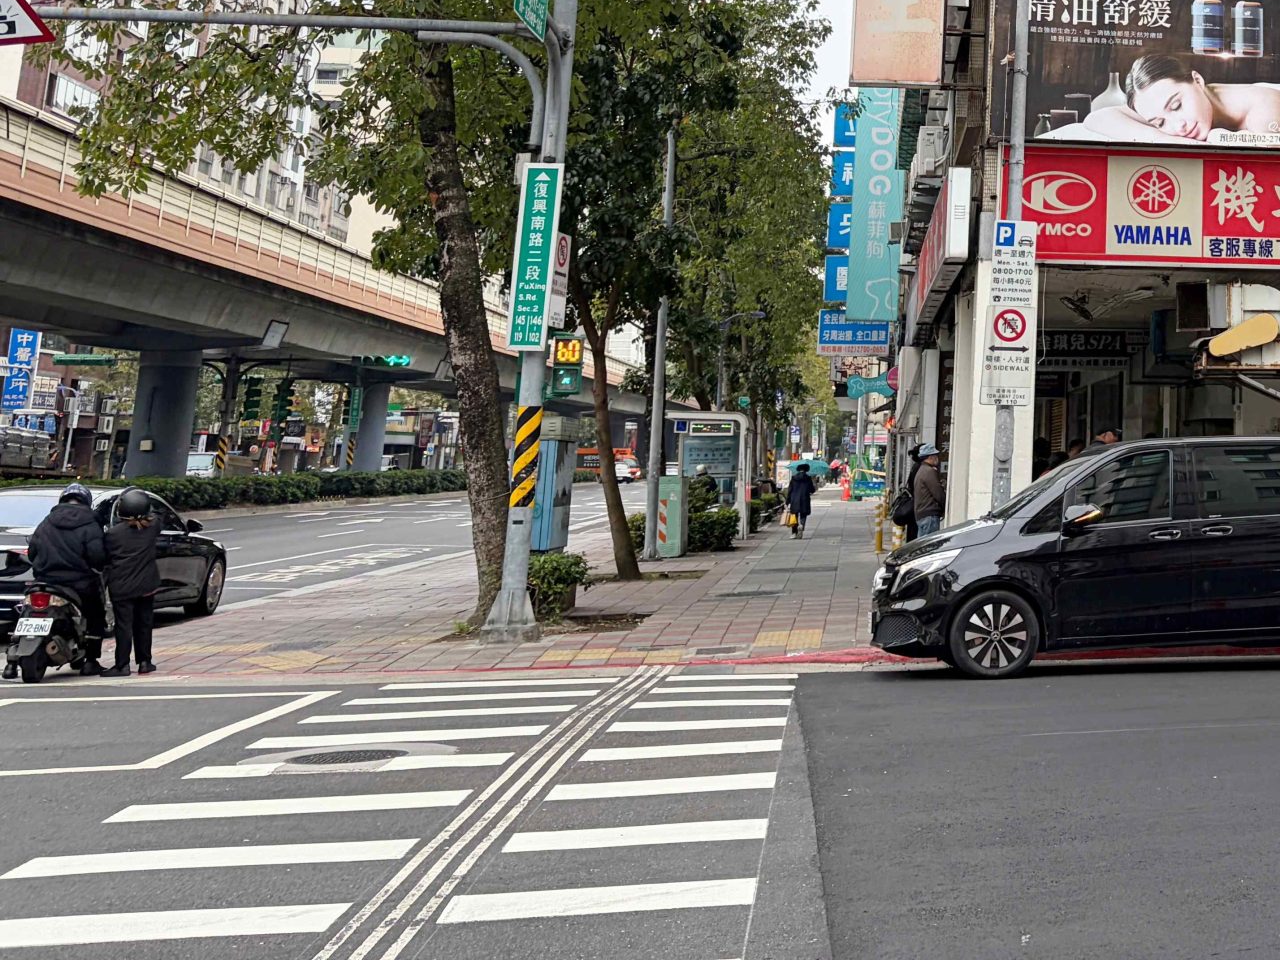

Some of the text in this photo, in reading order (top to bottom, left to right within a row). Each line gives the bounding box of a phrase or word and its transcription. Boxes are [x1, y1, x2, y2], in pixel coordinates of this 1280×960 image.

[525, 182, 548, 281] 復興南路二段
[866, 201, 887, 258] 蘇菲狗
[999, 226, 1012, 243] P
[1036, 223, 1092, 237] YMCO
[1114, 225, 1192, 246] YAMAHA
[519, 283, 546, 292] FuXing
[515, 316, 542, 326] 145 146
[514, 332, 540, 342] 119 102
